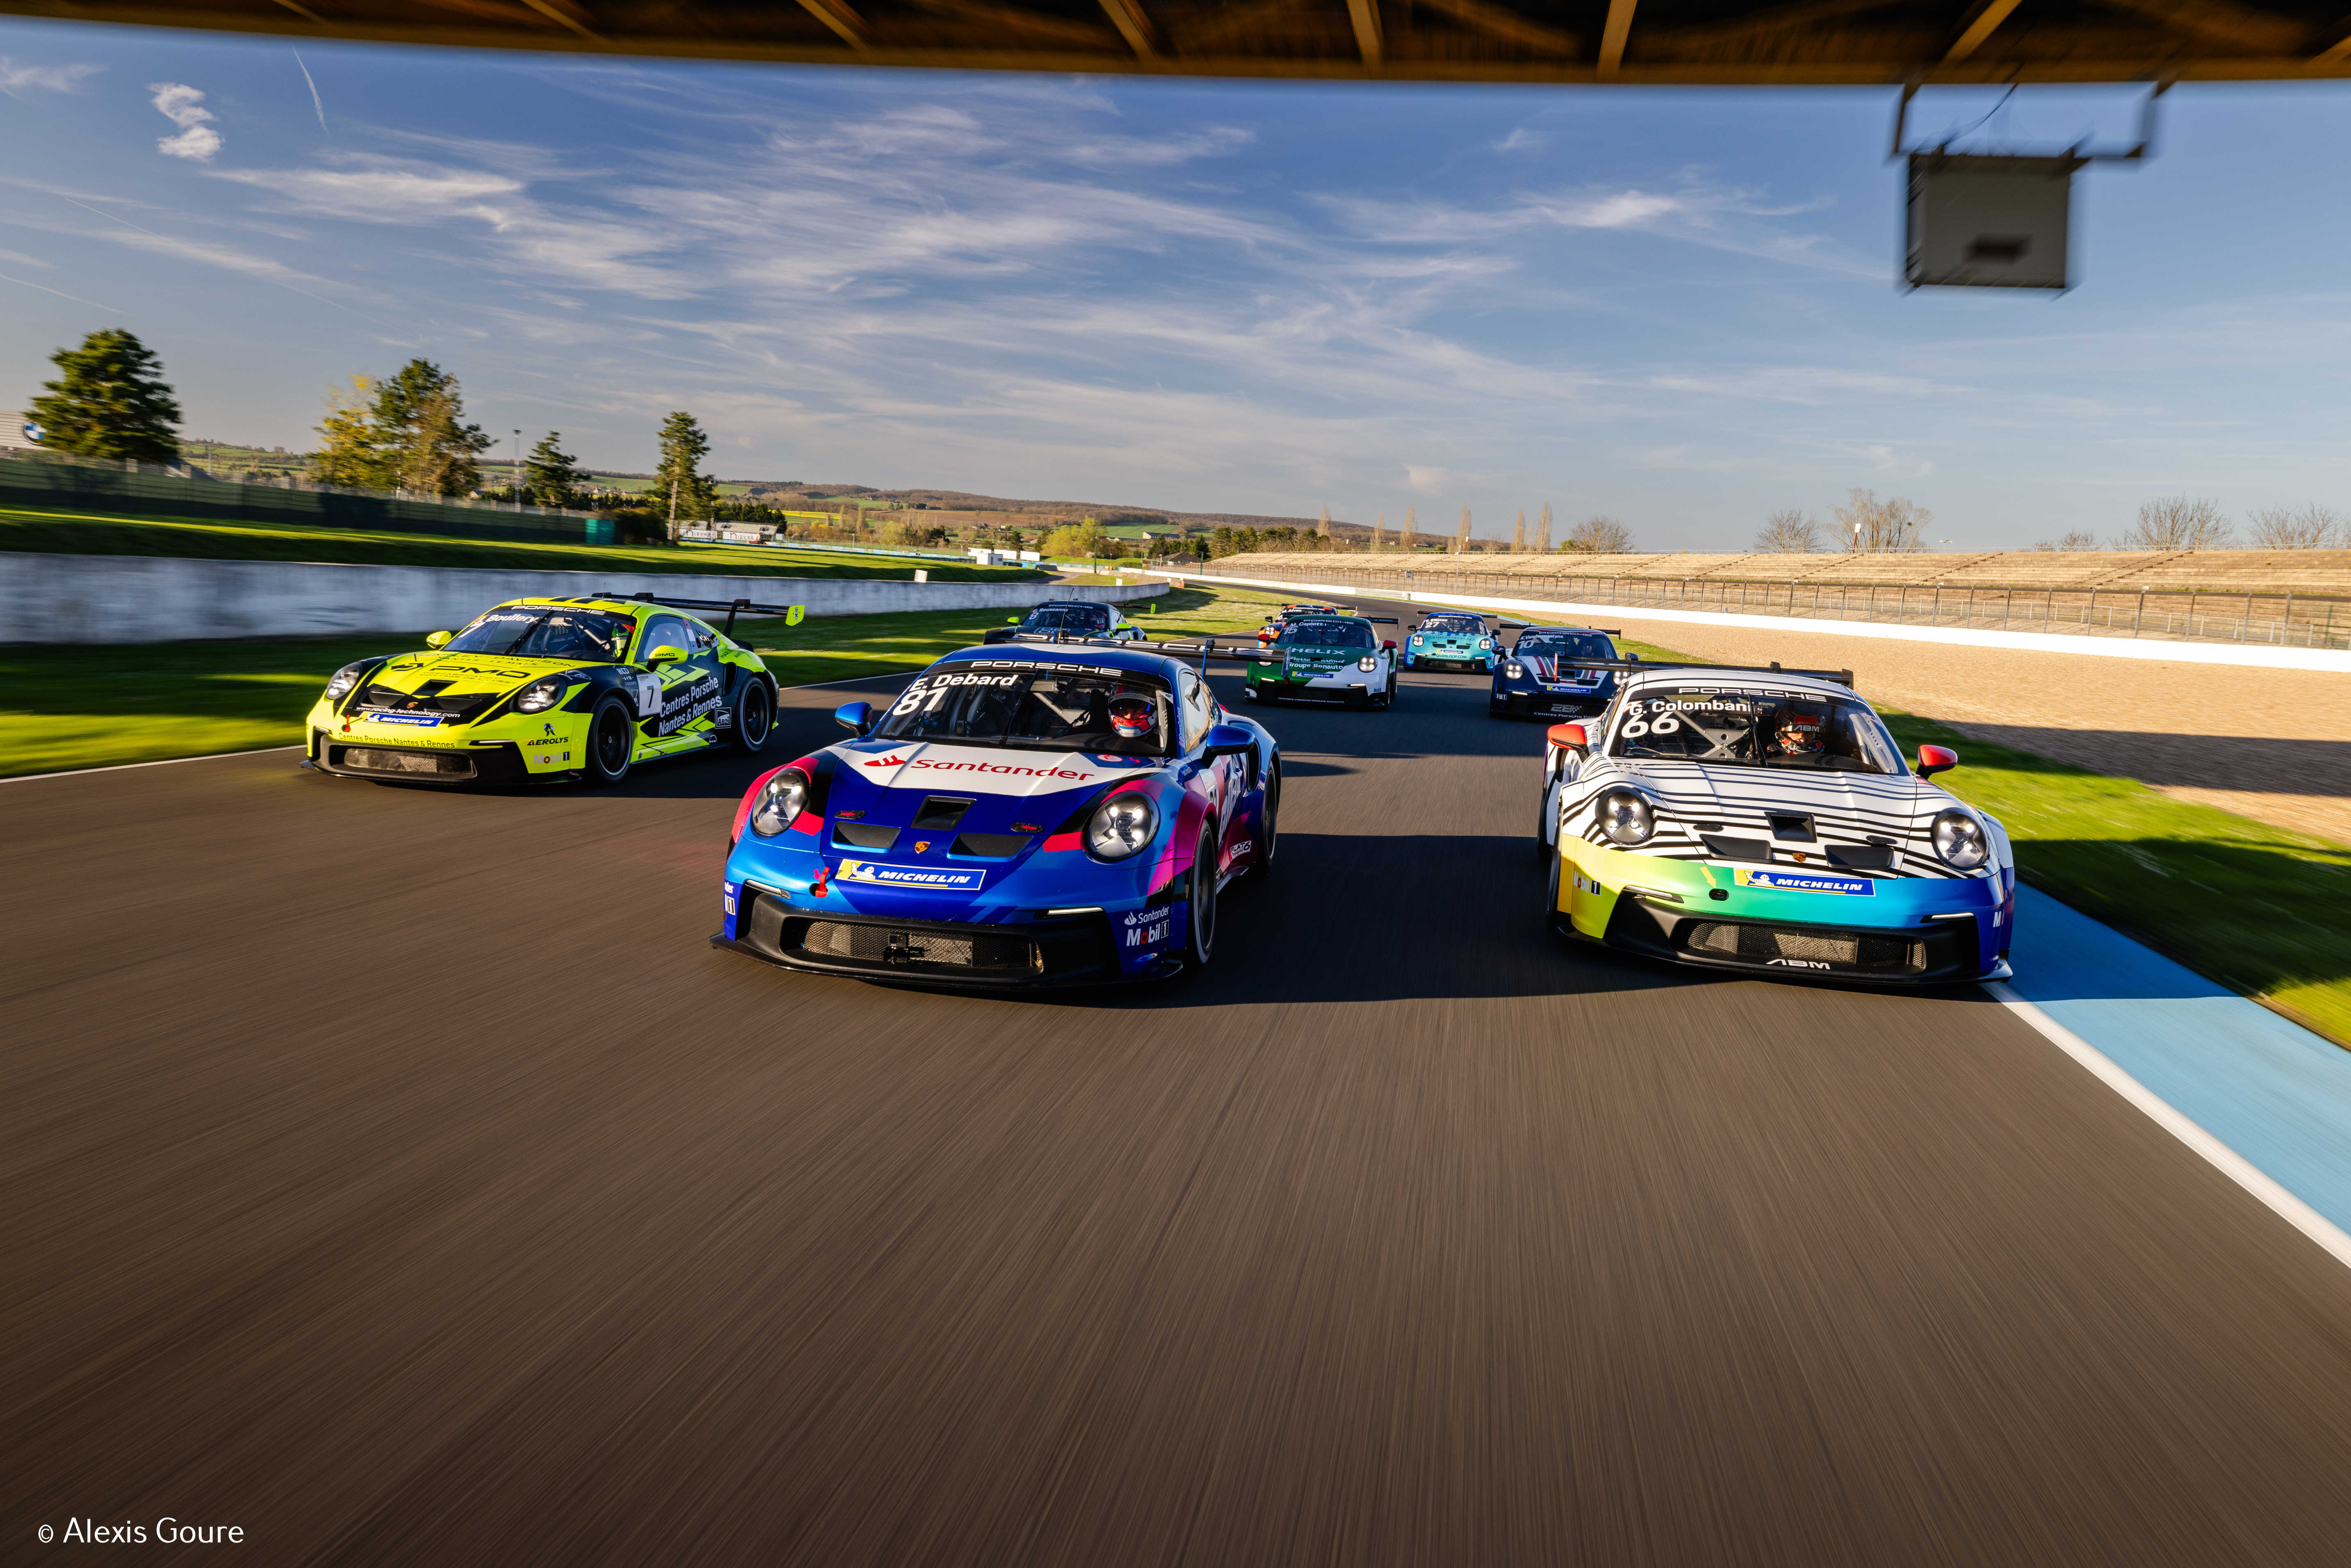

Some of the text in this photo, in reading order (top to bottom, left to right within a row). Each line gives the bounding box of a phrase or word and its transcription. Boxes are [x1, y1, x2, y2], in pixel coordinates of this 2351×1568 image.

[511, 605, 606, 615] PORSCHE
[485, 614, 540, 624] Boullery
[458, 622, 485, 638] 7
[1283, 626, 1299, 635] 15
[1012, 633, 1274, 656] PORSCHE
[1518, 640, 1535, 649] 10
[429, 665, 531, 679] PMO
[970, 661, 1123, 677] PORSCHE
[909, 673, 1019, 692] E. Debard
[647, 685, 654, 709] 7
[660, 693, 690, 718] Centres
[690, 677, 719, 702] Porsche
[892, 687, 949, 716] 81
[1678, 688, 1827, 702] PORSCHE
[356, 707, 461, 718] www.racing-technology.com
[658, 695, 722, 737] Nantes & Rennes
[1629, 700, 1752, 716] G. Colombani
[380, 717, 435, 725] MICHELIN
[1621, 712, 1680, 739] 66
[339, 732, 363, 742] Centres
[364, 736, 392, 745] Porsche
[394, 738, 419, 747] Nantes
[427, 740, 455, 748] Rennes
[526, 736, 569, 746] AEROLYS
[533, 752, 561, 764] Mobil
[910, 759, 1094, 781] Santander
[878, 871, 971, 884] MICHELIN
[1573, 871, 1590, 893] Mobil
[1776, 878, 1863, 891] MICHELIN
[1138, 906, 1169, 924] Santander
[1126, 923, 1161, 946] Mobil
[1766, 959, 1831, 970] ABM
